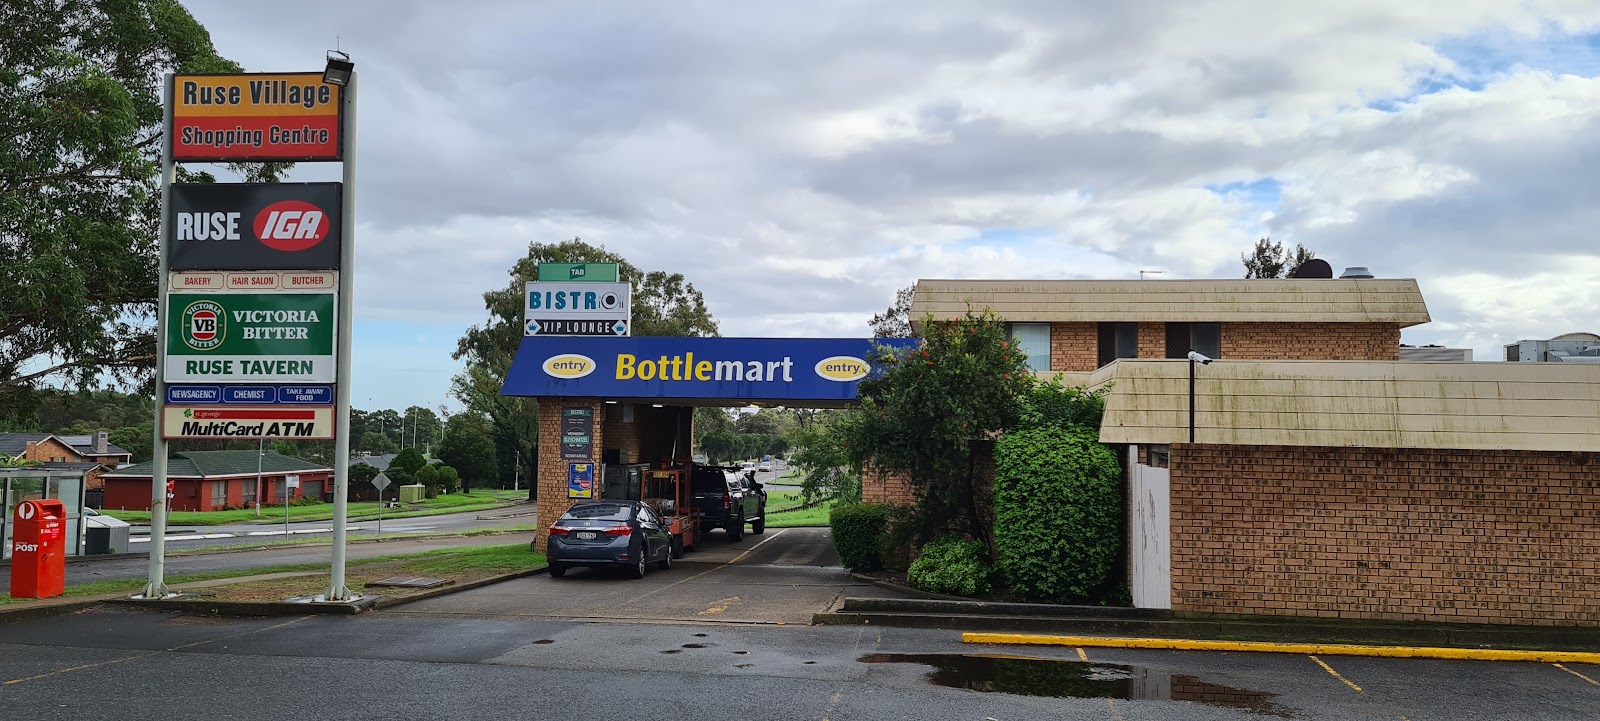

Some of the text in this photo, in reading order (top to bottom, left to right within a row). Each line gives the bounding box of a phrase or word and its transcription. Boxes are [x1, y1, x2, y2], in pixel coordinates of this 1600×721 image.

[183, 80, 331, 108] Ruse Village
[181, 125, 329, 148] Shopping Centre
[177, 210, 323, 241] RUSE IGA
[571, 268, 585, 276] TAB
[184, 277, 212, 286] BAKERY
[231, 277, 274, 286] HAIR SALON
[291, 276, 324, 285] BUTCHER
[186, 303, 222, 316] VICTORIA
[232, 310, 320, 323] VICTORIA
[193, 318, 216, 332] VB
[543, 321, 610, 333] VIP LOUNGE
[242, 327, 309, 340] BITTER
[188, 337, 220, 348] BITTER
[186, 360, 313, 375] RUSE TAVERN
[552, 361, 586, 372] entry
[615, 351, 794, 382] Bottlemart
[825, 363, 861, 375] entry
[171, 390, 217, 399] NEWSAGENCY
[233, 390, 265, 399] CHEMIST
[181, 421, 314, 436] MultiCard ATM
[15, 544, 39, 552] POST
